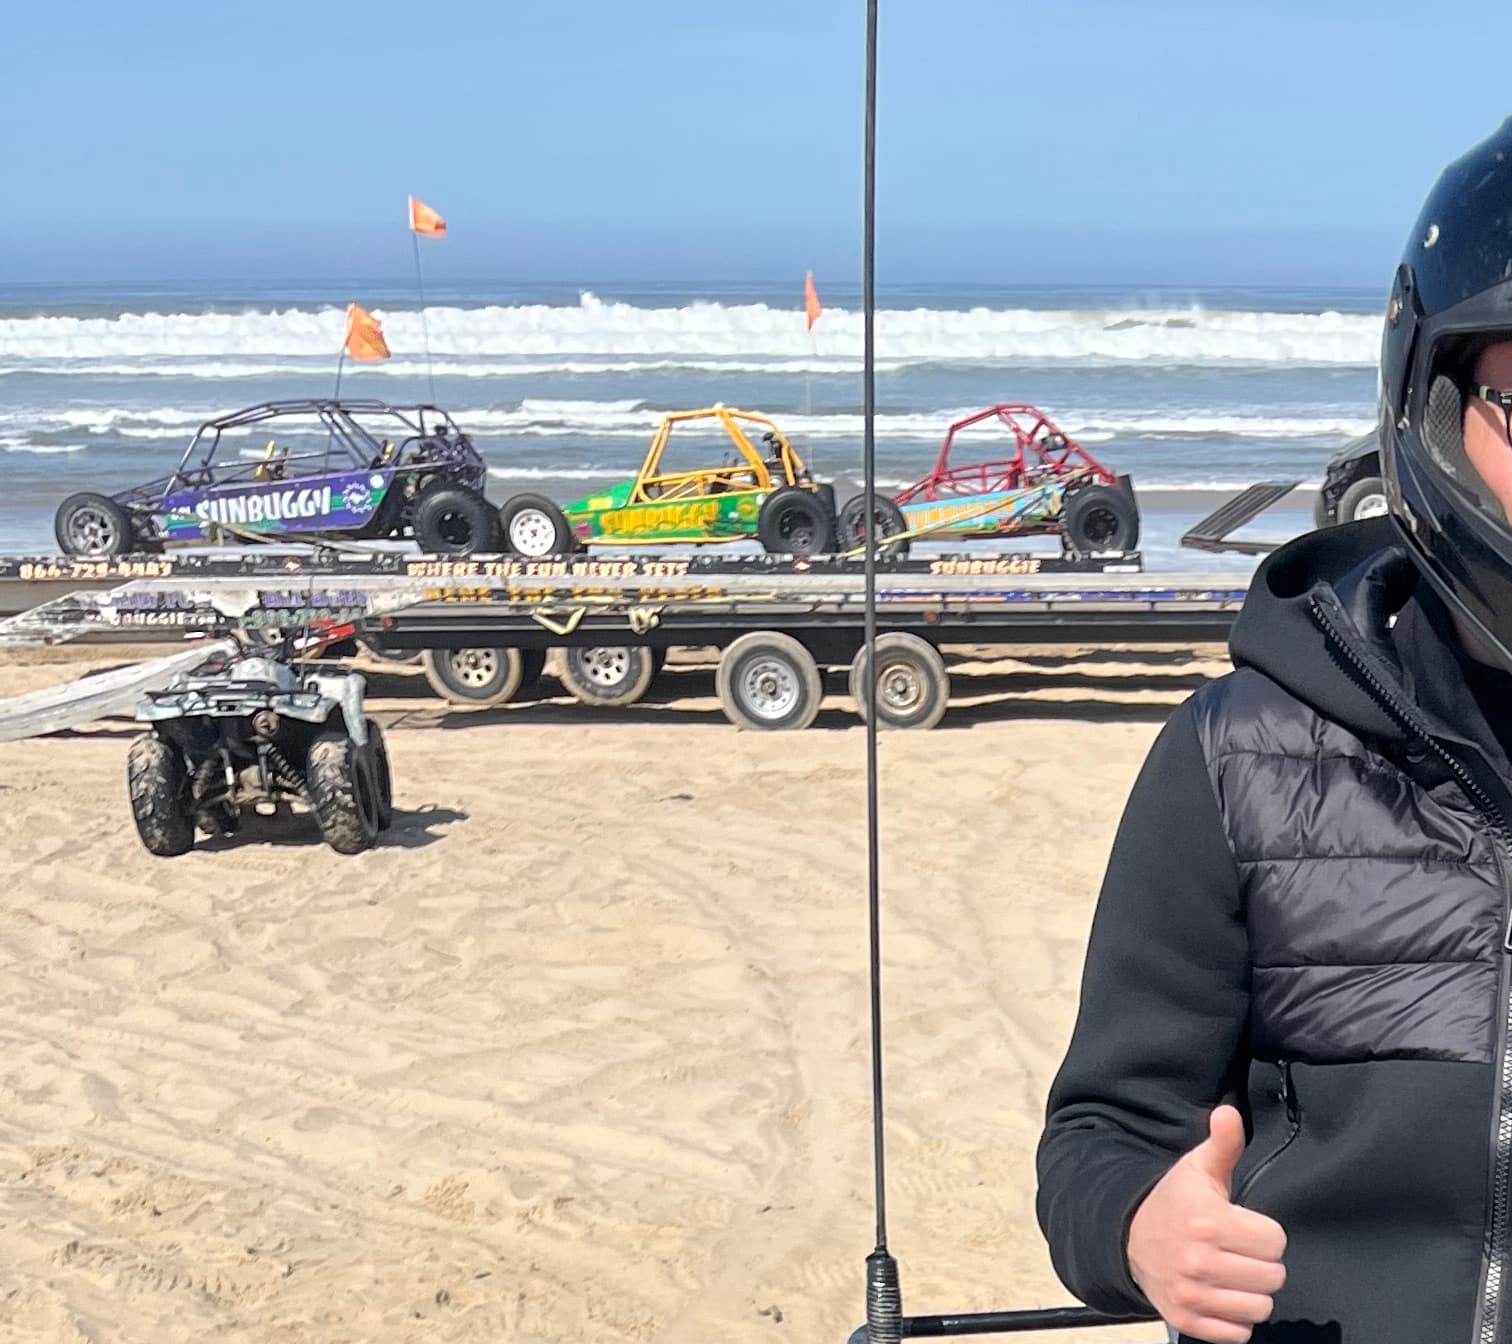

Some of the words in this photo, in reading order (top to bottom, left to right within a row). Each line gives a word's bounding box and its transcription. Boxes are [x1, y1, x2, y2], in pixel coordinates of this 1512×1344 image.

[196, 486, 331, 527] SUNBUGGY
[407, 561, 479, 577] WHERE
[484, 561, 522, 577] THE
[526, 561, 568, 577] FUN
[572, 561, 638, 577] NEVER
[642, 561, 690, 577] SETS
